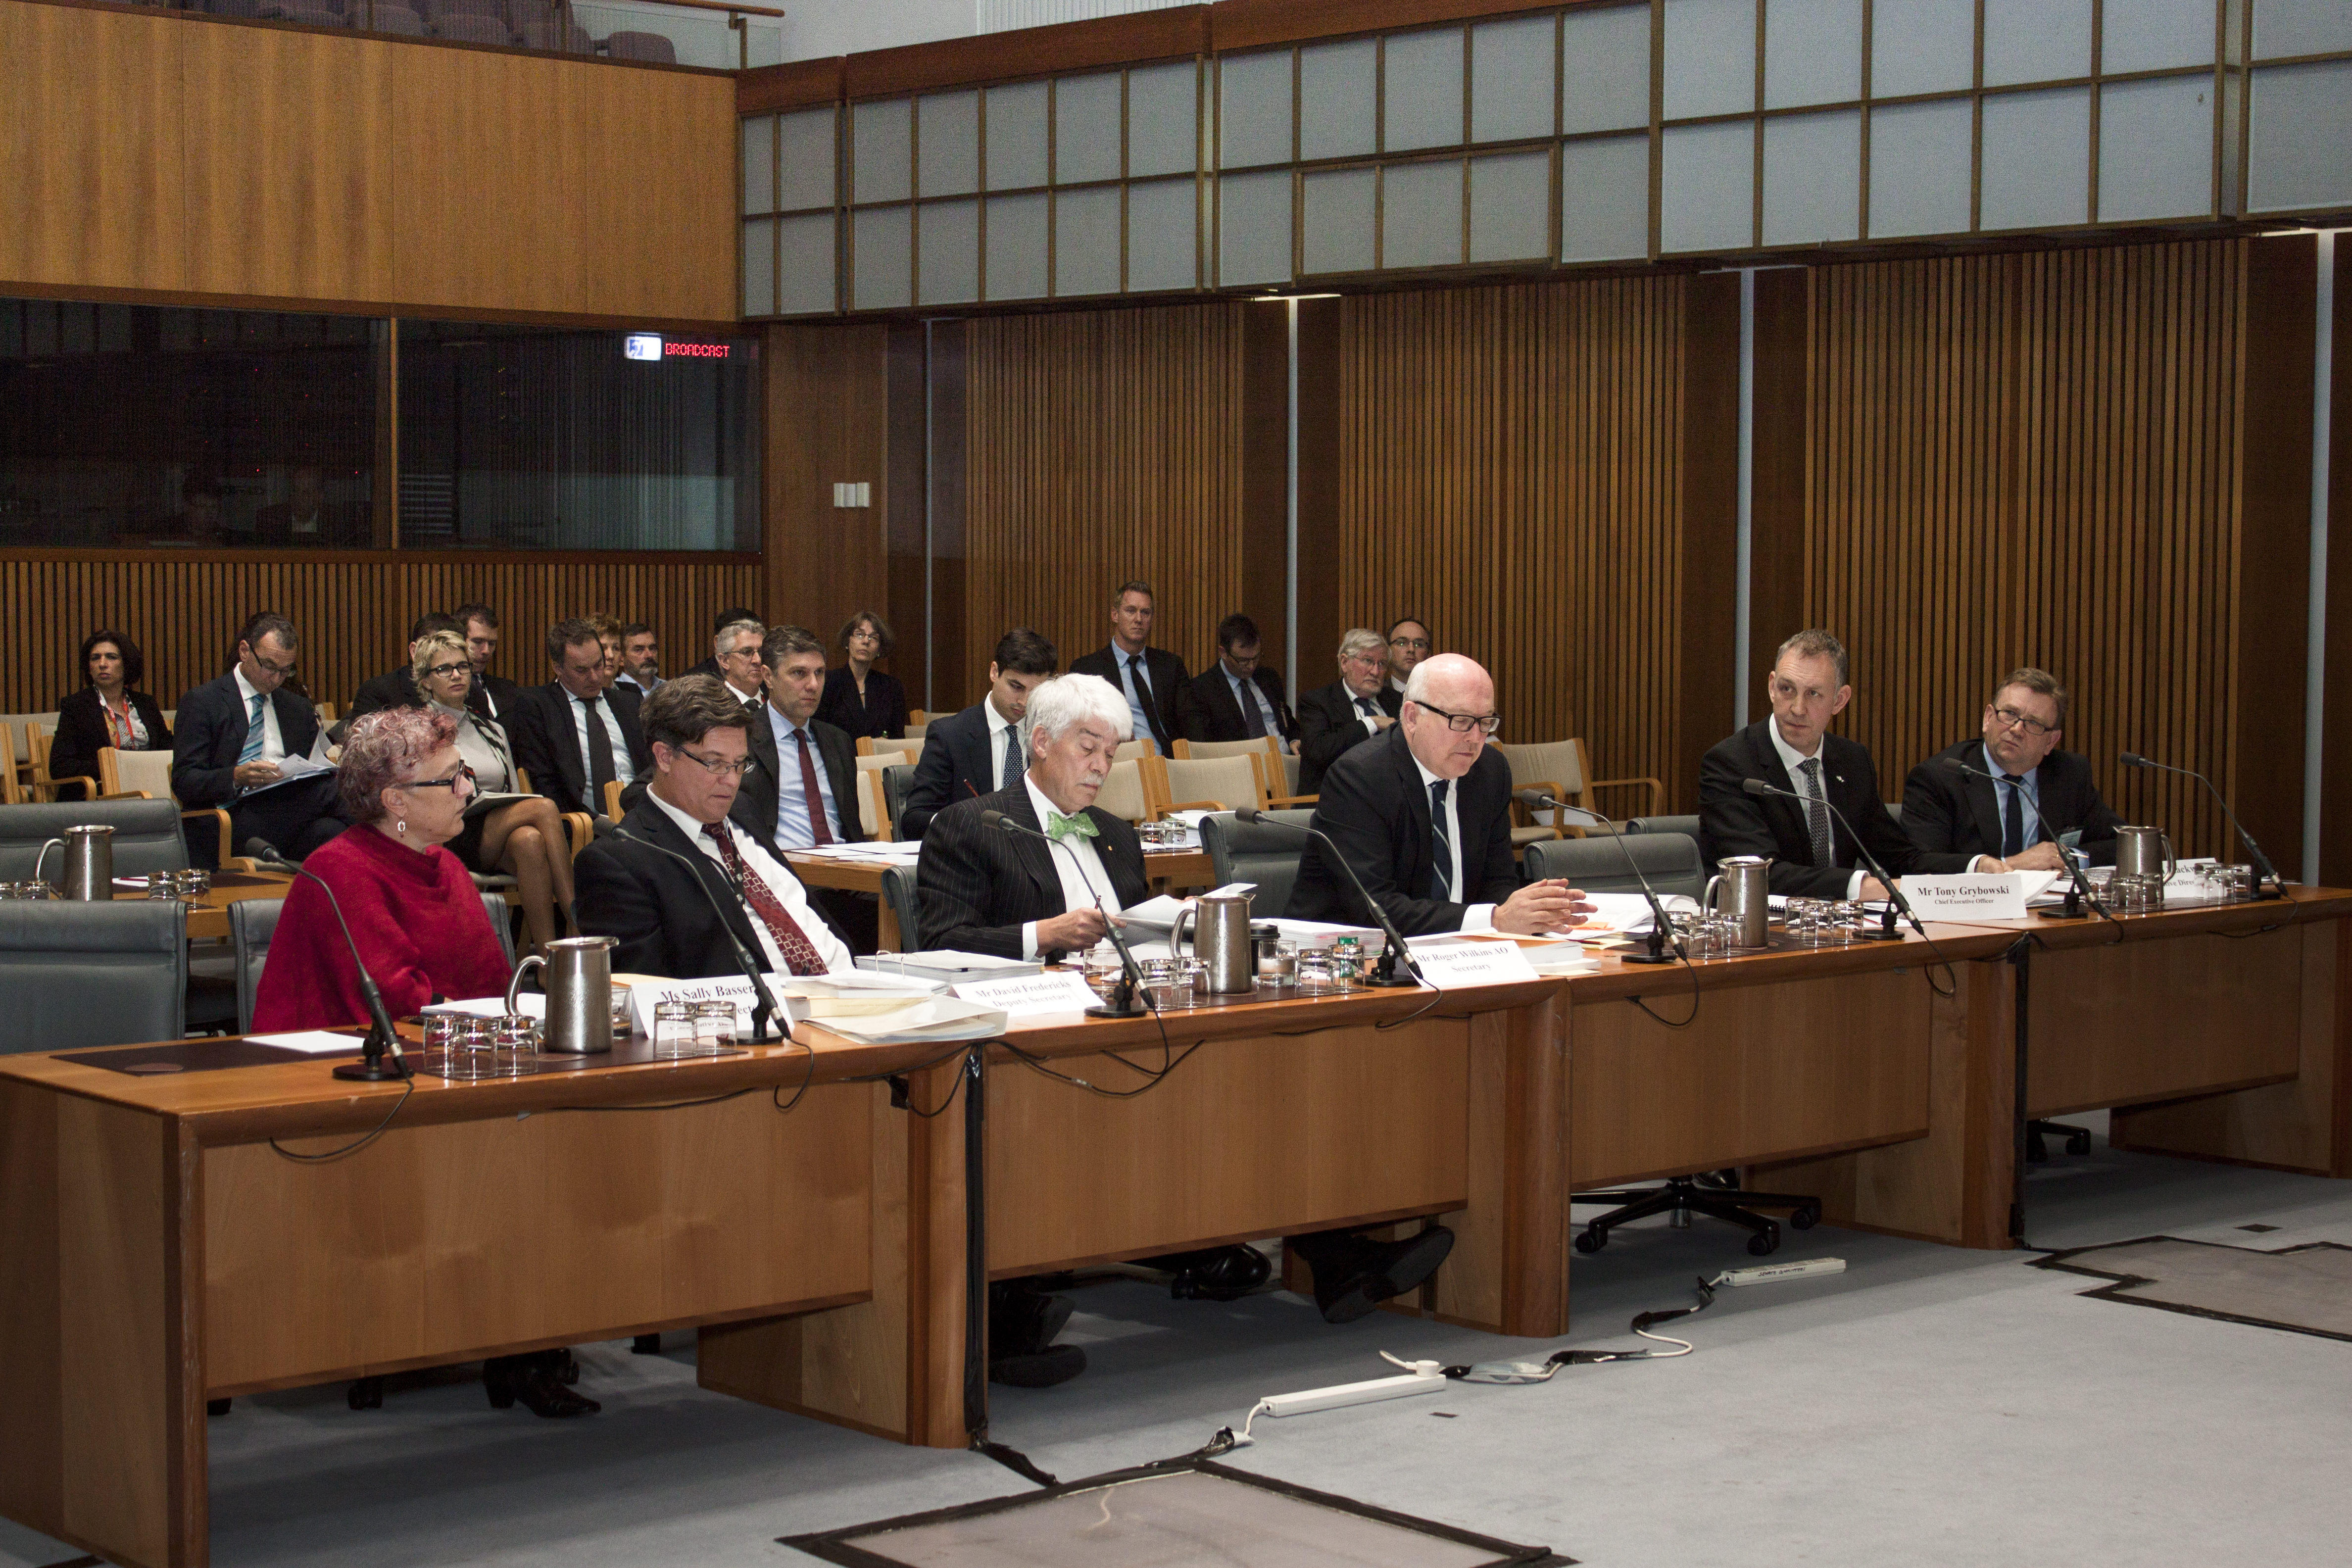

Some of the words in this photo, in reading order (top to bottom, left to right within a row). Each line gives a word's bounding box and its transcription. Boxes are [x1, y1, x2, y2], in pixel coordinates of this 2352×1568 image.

[665, 343, 730, 357] BROADCAST
[1917, 887, 1932, 896] Mr
[1934, 887, 1956, 897] Tony
[1959, 885, 2009, 897] Grybowski
[1432, 953, 1458, 961] Roger
[1459, 949, 1493, 958] Wilkins
[1451, 964, 1491, 973] Secretary
[660, 990, 680, 1001] Ms
[682, 987, 712, 1001] Sally
[992, 985, 1021, 996] David
[1022, 980, 1072, 992] Fredericks
[992, 999, 1028, 1007] Deputy
[1029, 993, 1072, 1004] Secretary
